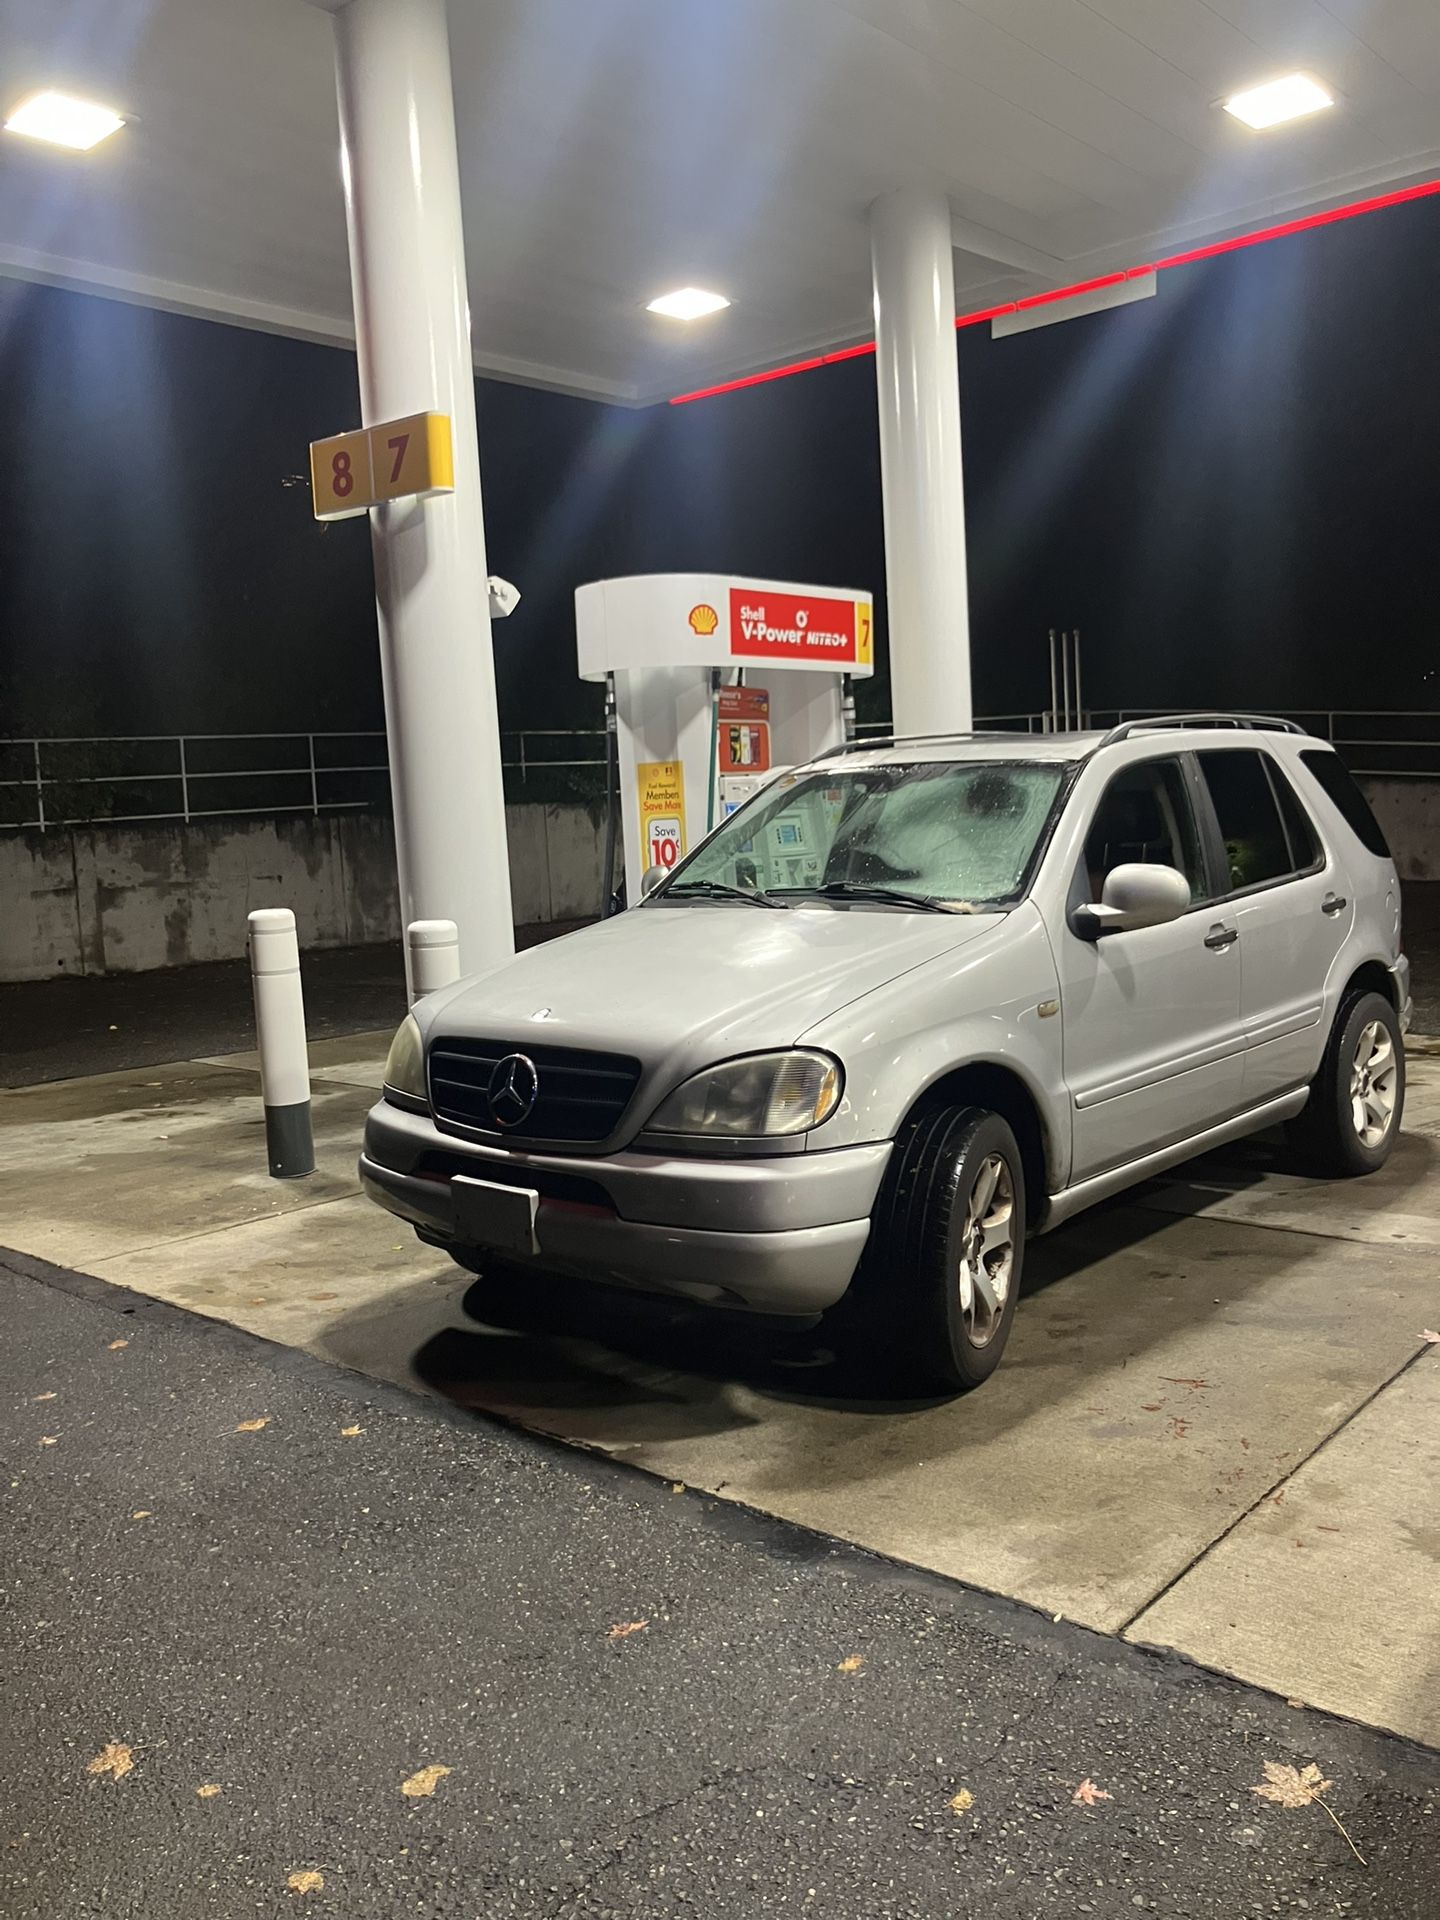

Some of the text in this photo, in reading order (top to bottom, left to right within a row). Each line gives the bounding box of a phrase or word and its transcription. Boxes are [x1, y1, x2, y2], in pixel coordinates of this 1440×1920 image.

[332, 434, 410, 498] 8 7
[740, 605, 765, 621] Shell
[741, 621, 802, 644] V-Power
[862, 619, 870, 647] 7
[643, 801, 663, 811] Save
[655, 826, 676, 836] Save
